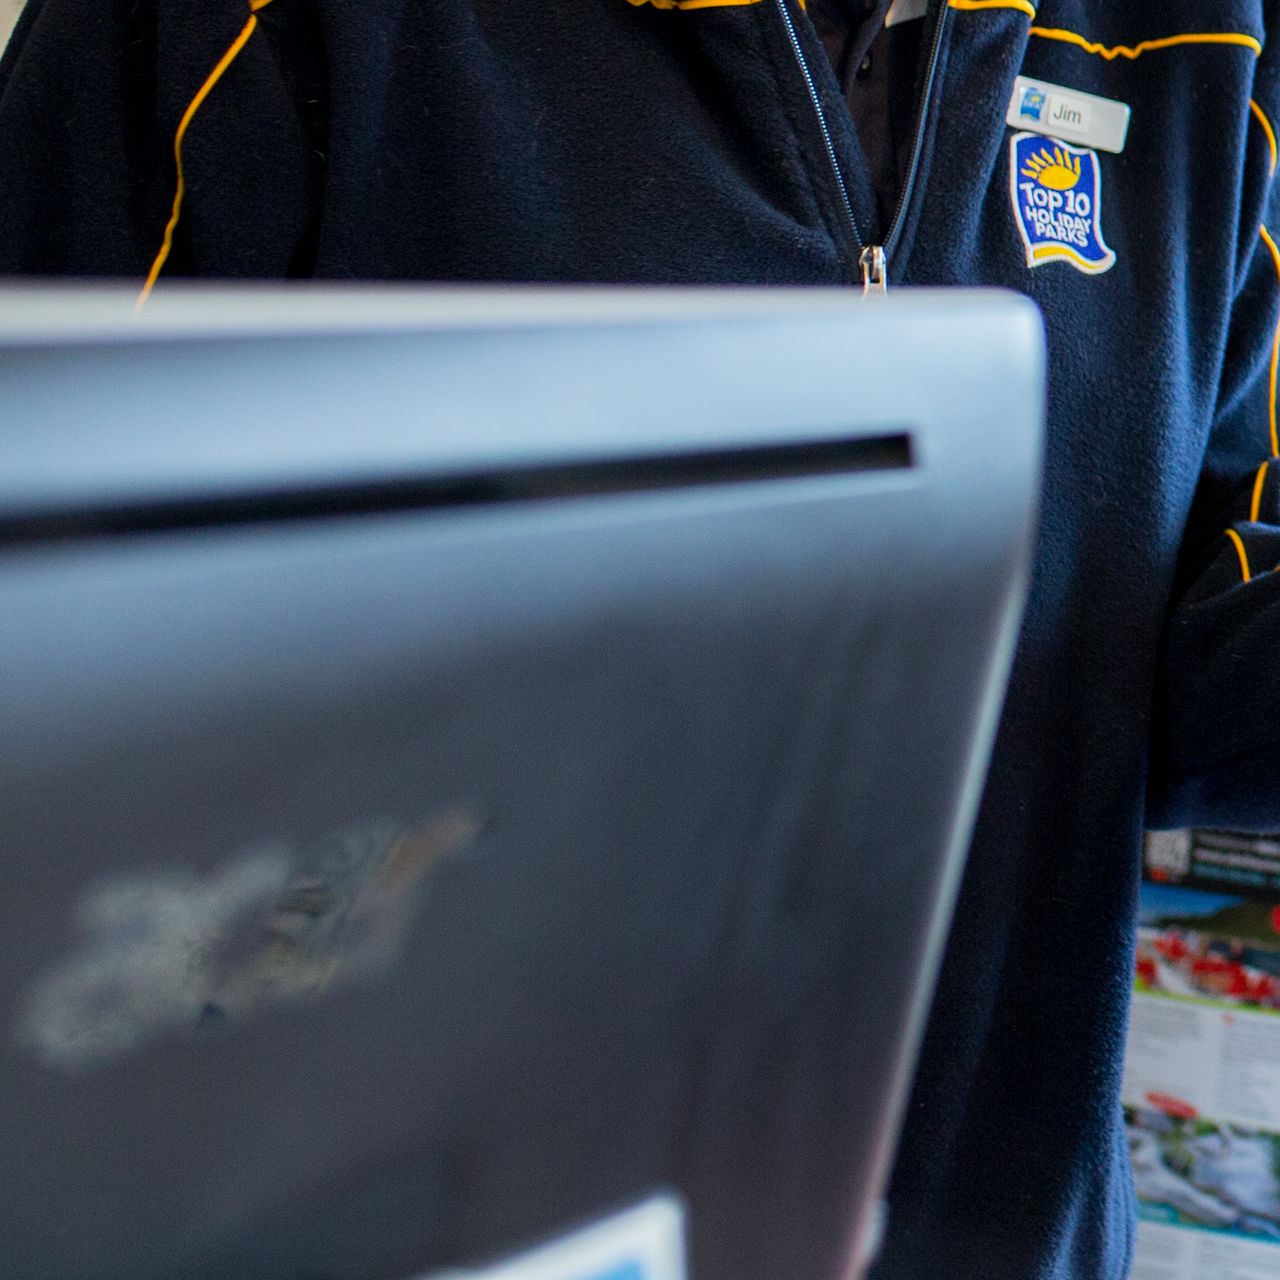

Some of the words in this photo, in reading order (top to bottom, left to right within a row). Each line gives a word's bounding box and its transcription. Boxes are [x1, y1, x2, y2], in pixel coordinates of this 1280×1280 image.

[1053, 104, 1082, 124] Jim
[1065, 190, 1091, 217] 10
[1026, 207, 1091, 234] HOLIDAY
[1036, 223, 1088, 248] PARKS
